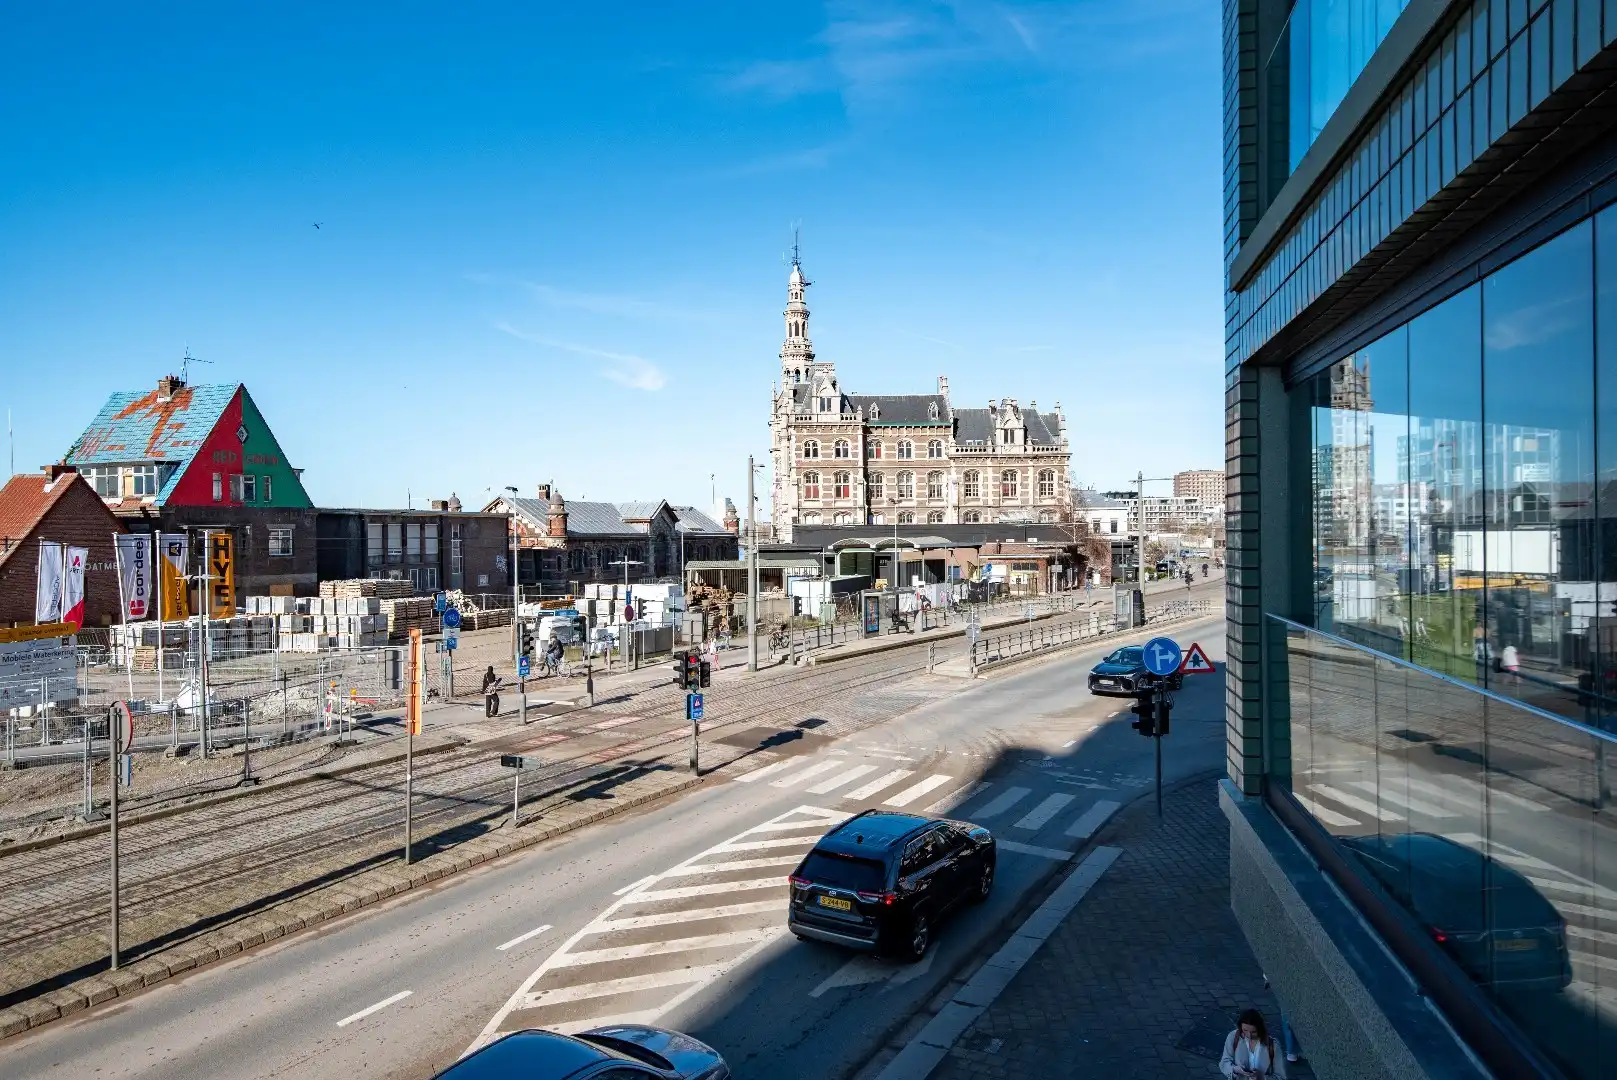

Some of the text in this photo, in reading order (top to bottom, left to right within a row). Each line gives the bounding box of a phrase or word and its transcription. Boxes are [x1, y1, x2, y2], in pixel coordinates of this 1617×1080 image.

[134, 537, 145, 597] cordeel
[213, 537, 231, 607] HYE
[2, 650, 75, 663] Mobiele Waterkering
